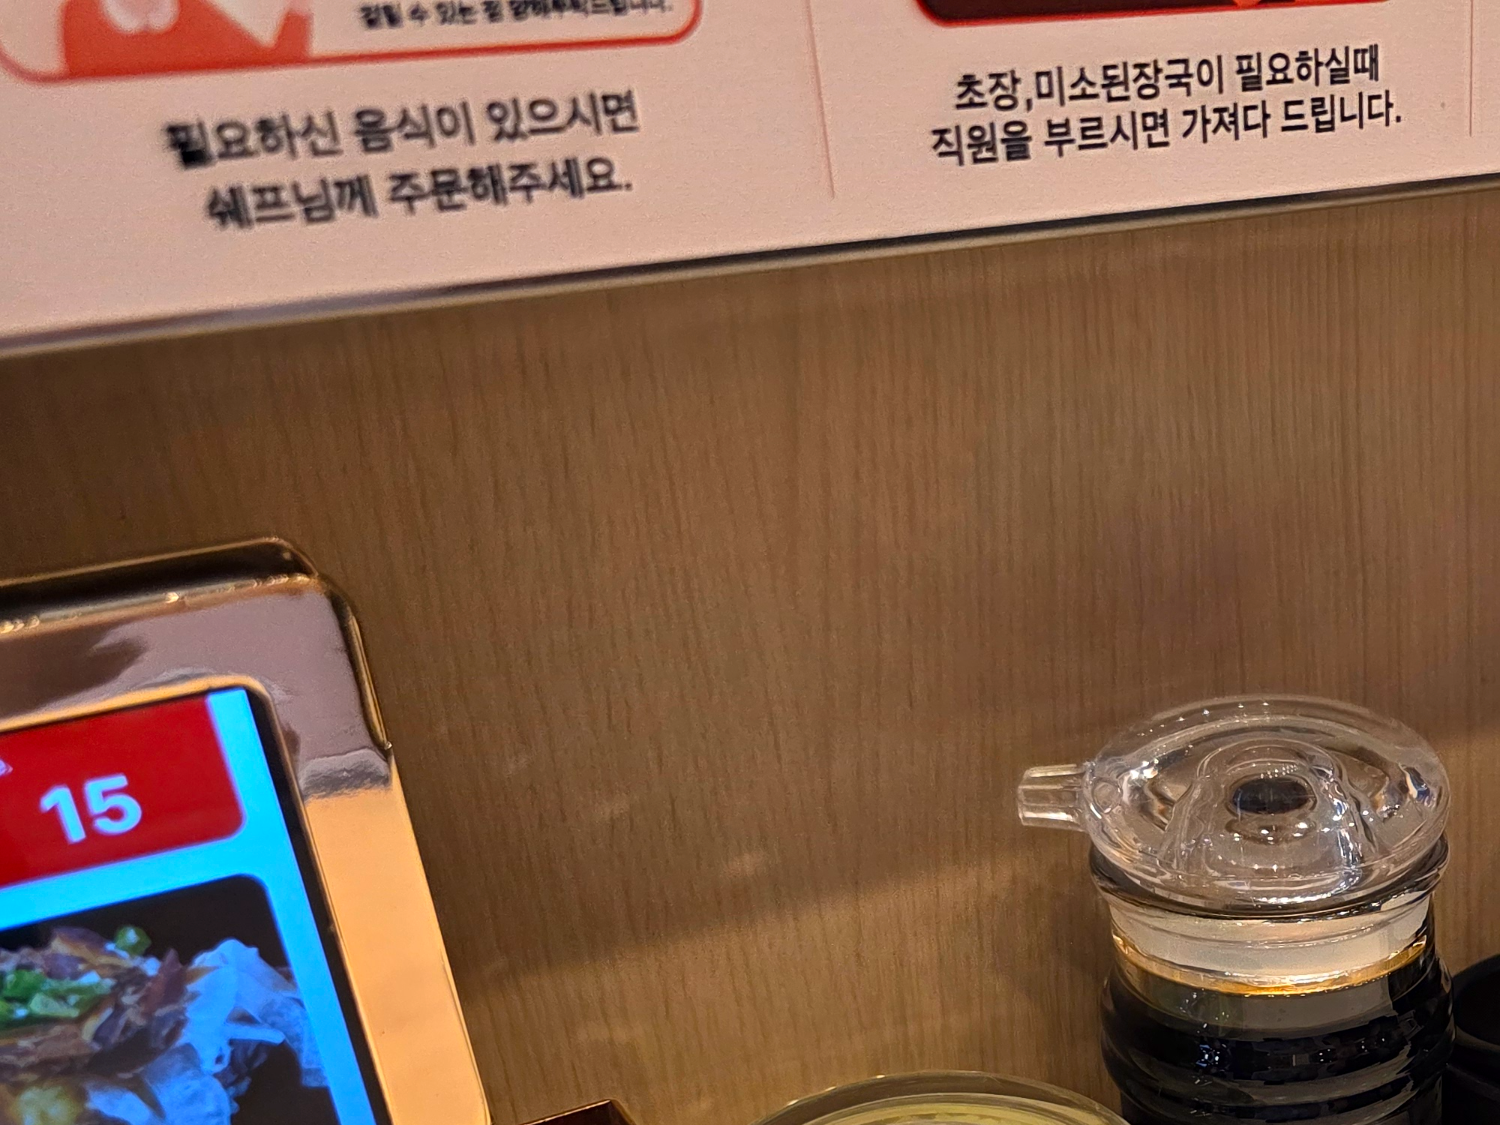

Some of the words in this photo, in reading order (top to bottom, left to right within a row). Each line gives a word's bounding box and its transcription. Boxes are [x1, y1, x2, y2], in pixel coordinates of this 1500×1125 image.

[954, 56, 1224, 112] 초장,미소된장국이
[1233, 44, 1380, 92] 필요하실때
[163, 110, 343, 171] 필요하신
[352, 101, 476, 154] 음식이
[486, 90, 640, 140] 있으시면
[931, 120, 1033, 167] 직원을
[1043, 110, 1171, 158] 부르시면
[1181, 99, 1271, 144] 가져다
[1280, 89, 1402, 134] 드립니다.
[205, 174, 379, 229] 쉐프님께
[387, 156, 633, 214] 주문해주세요.
[39, 772, 143, 845] 15
